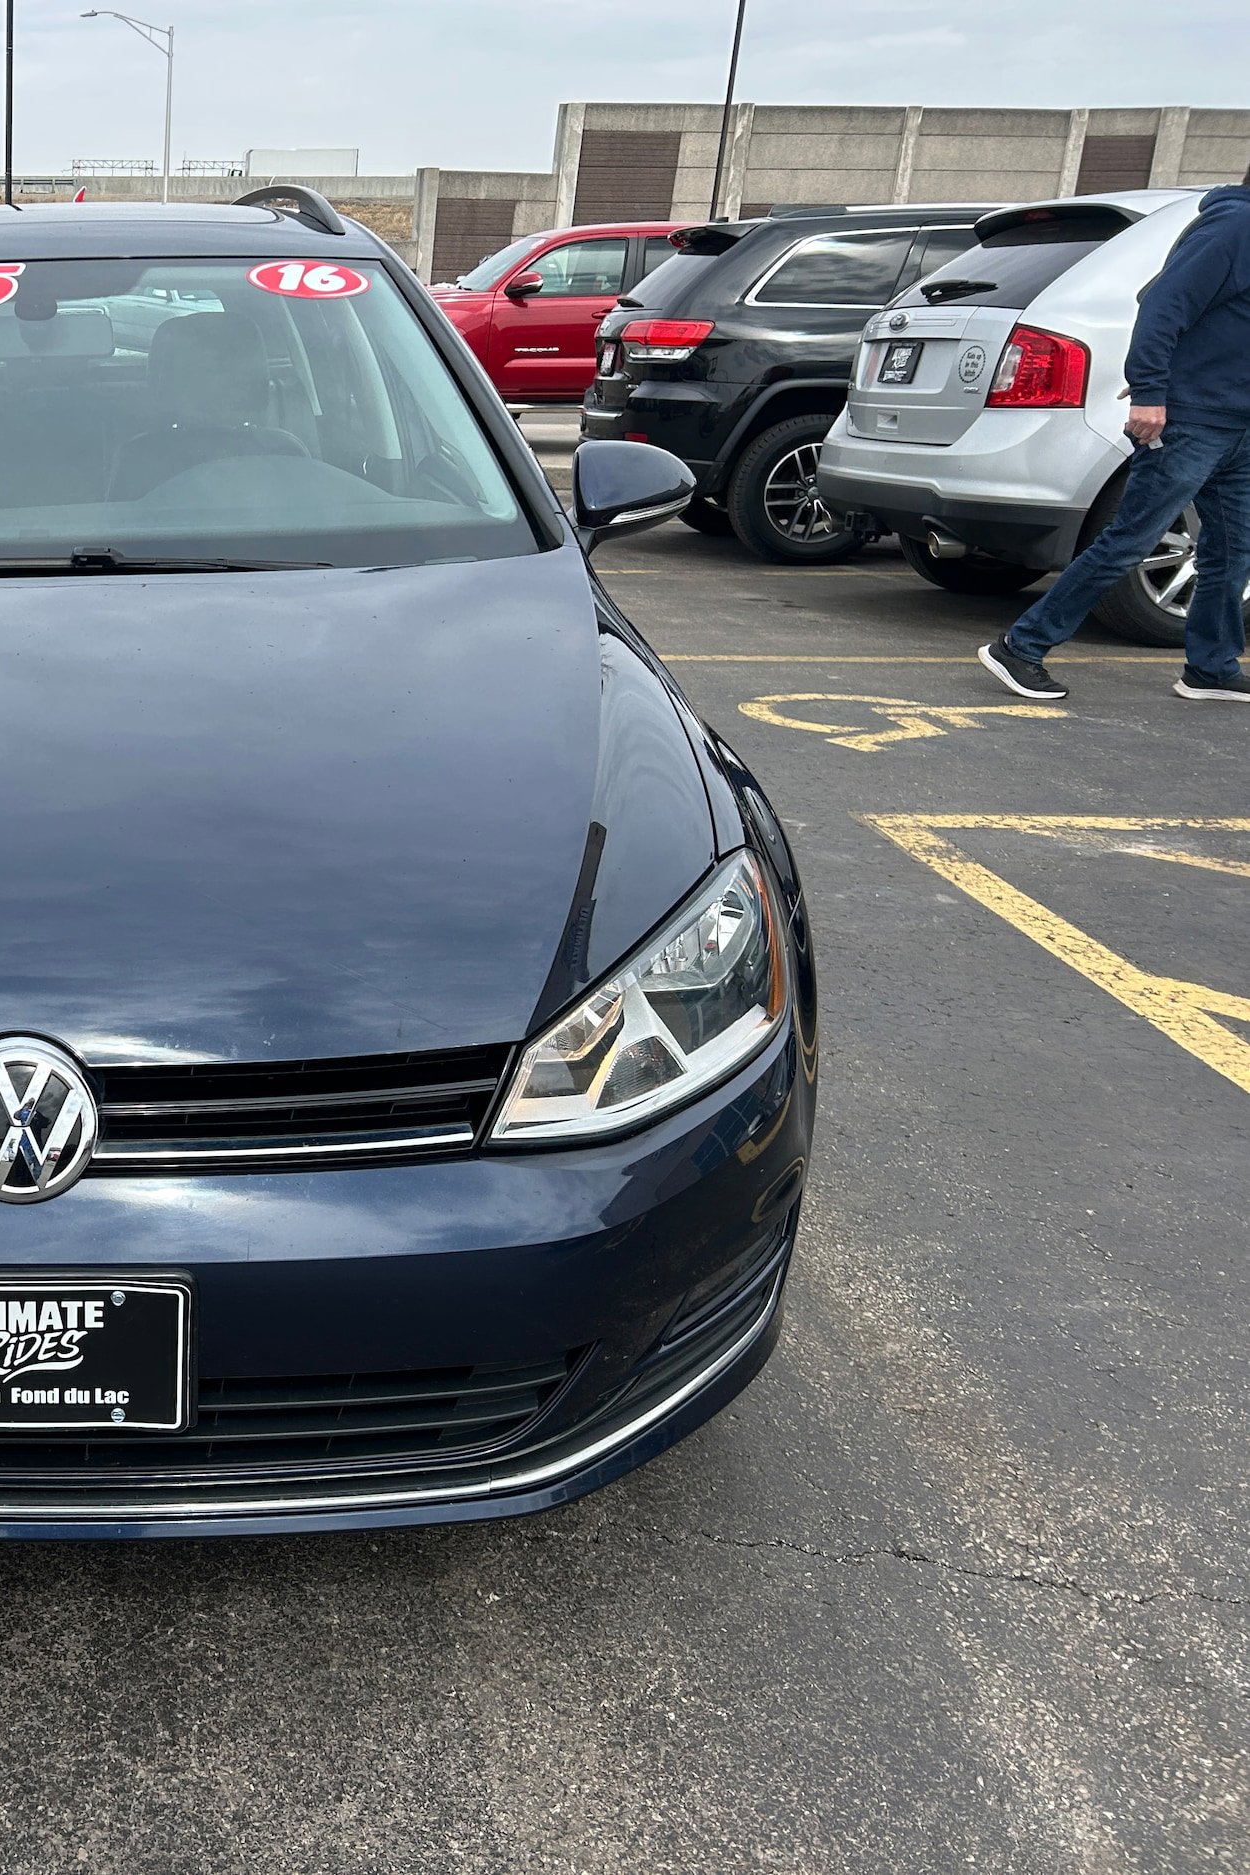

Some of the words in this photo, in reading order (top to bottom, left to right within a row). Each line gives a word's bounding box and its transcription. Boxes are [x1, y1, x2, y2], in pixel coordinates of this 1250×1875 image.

[277, 263, 347, 292] 16
[11, 1386, 62, 1405] Fond
[63, 1386, 92, 1405] du
[95, 1386, 130, 1405] Lac
